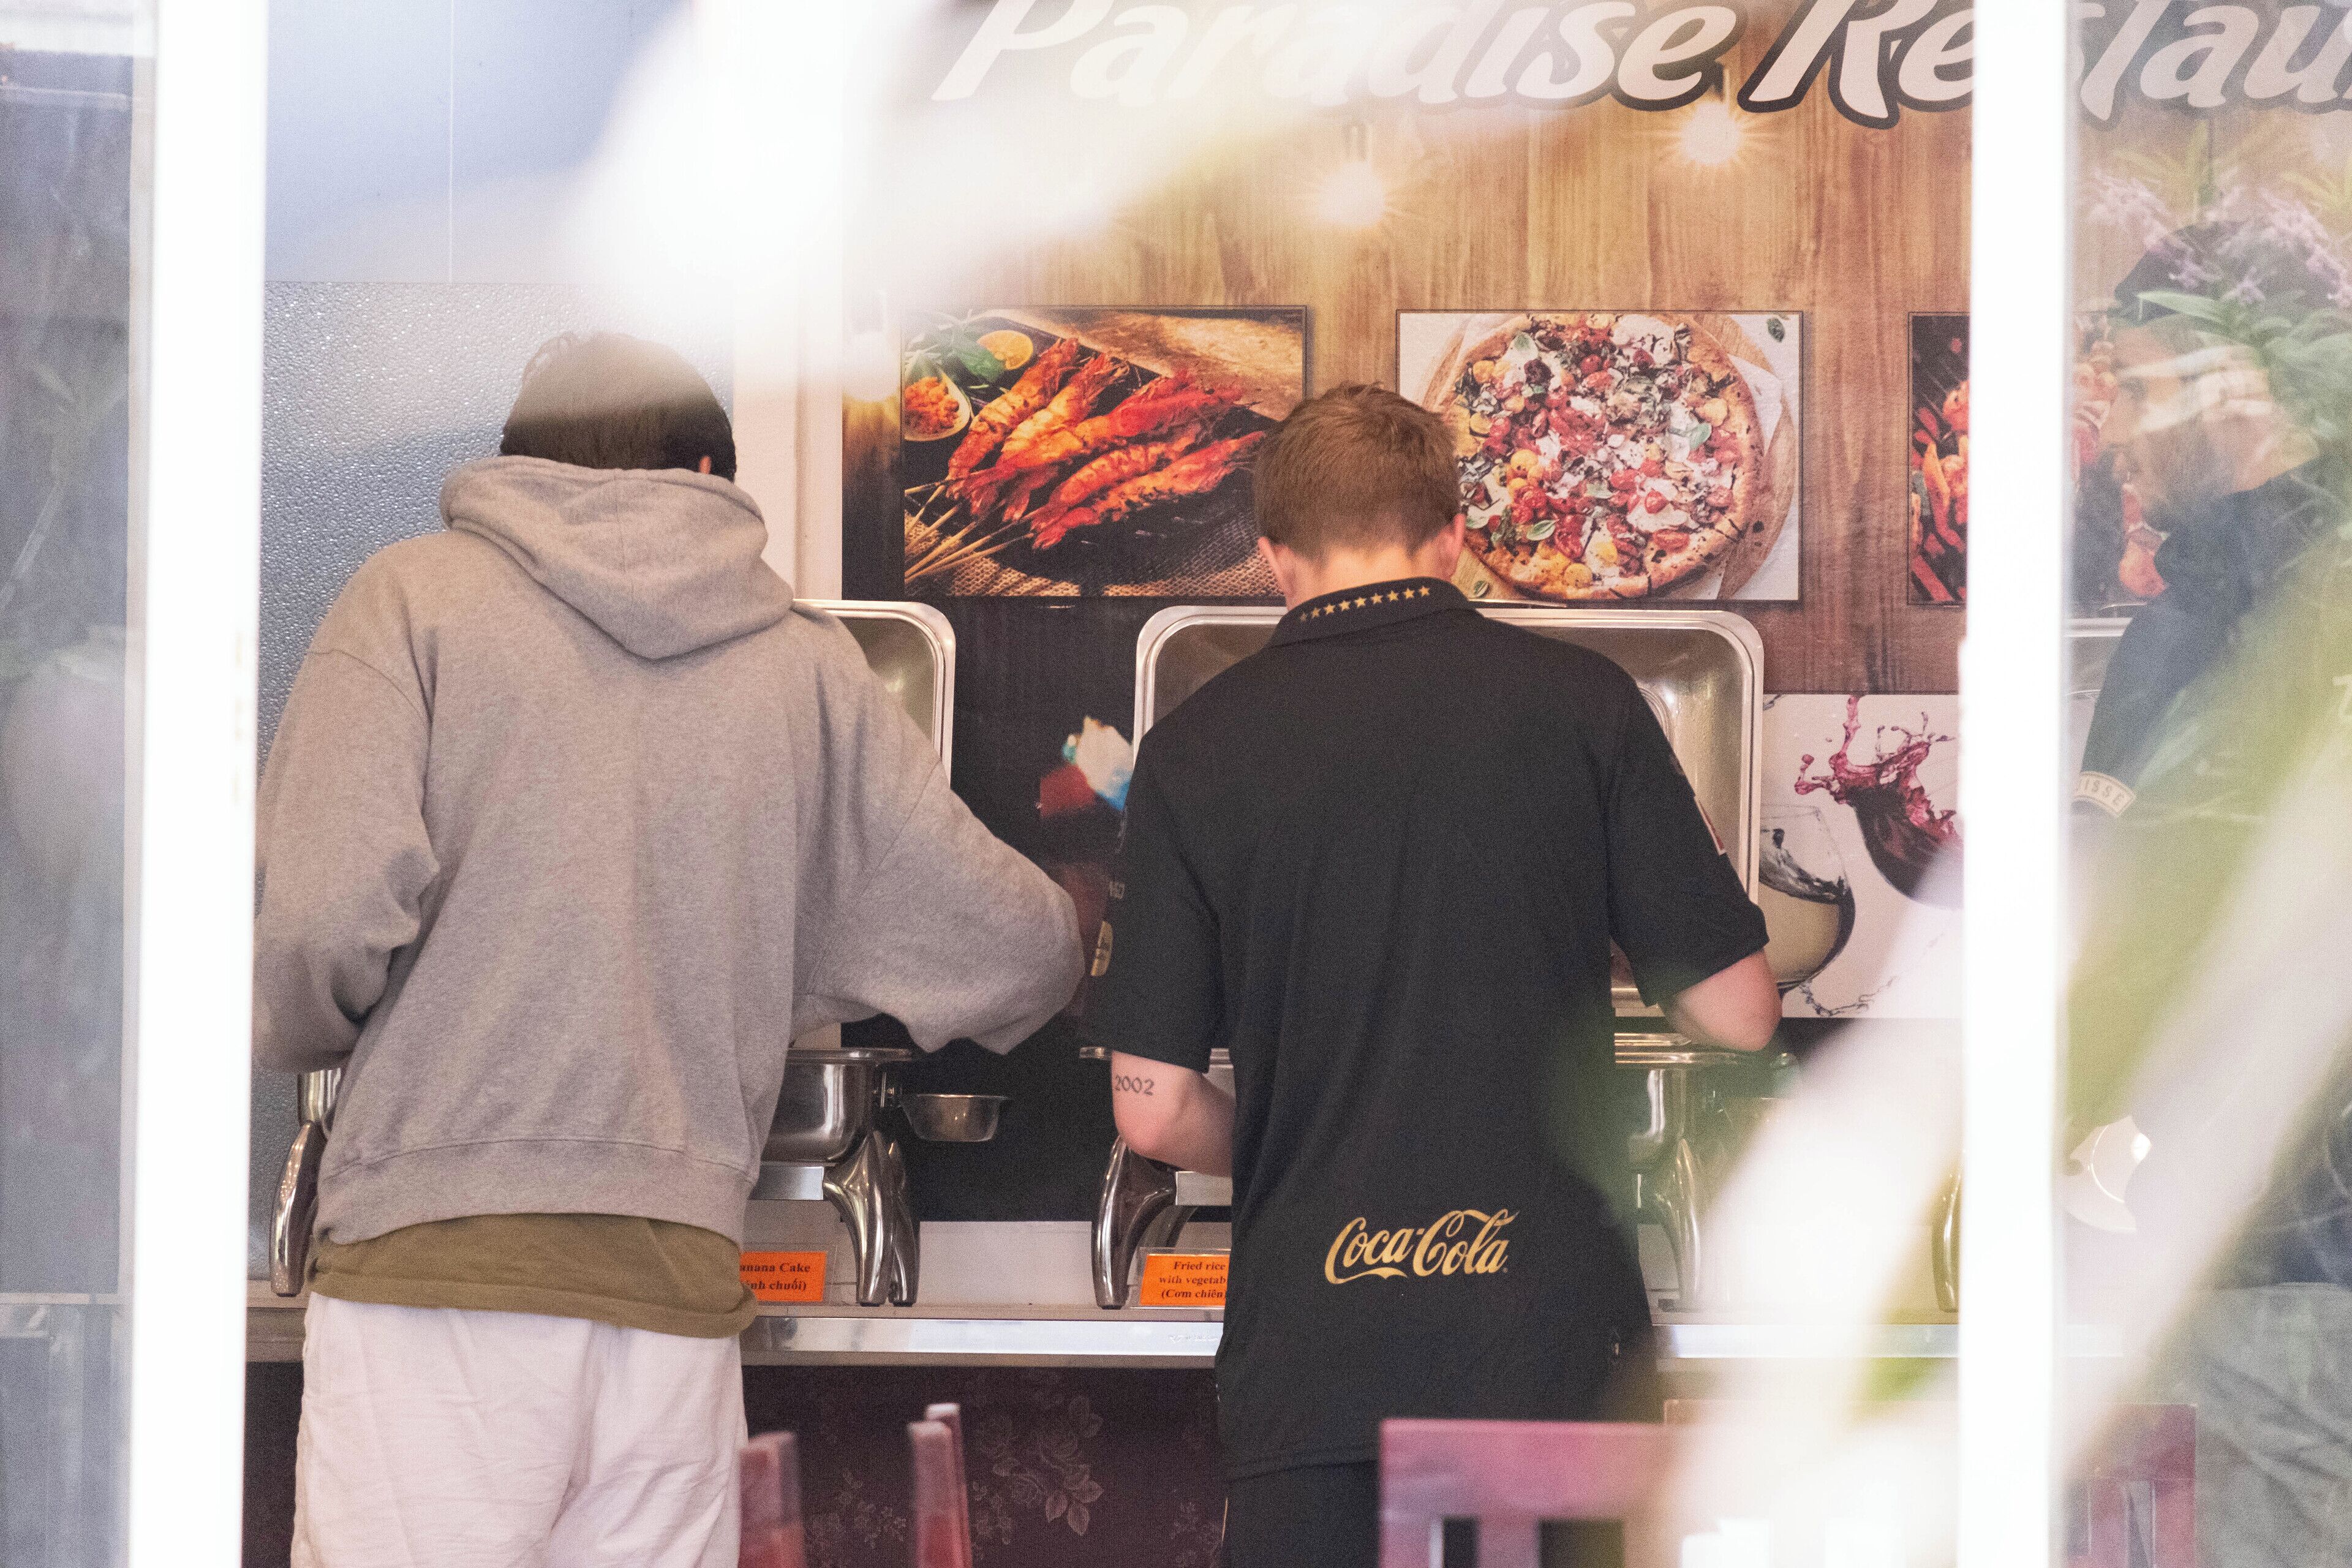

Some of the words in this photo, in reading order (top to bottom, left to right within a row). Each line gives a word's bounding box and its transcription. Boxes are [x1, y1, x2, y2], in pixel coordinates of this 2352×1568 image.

[929, 0, 1735, 113] Paradise
[1740, 0, 2352, 127] Retau
[1115, 1074, 1155, 1096] 2002
[1324, 1208, 1520, 1284] Coca-Cola
[779, 1262, 810, 1272] Cake
[1174, 1261, 1202, 1270] Fried
[1205, 1262, 1226, 1270] rice
[769, 1277, 807, 1292] chuối)
[1159, 1275, 1182, 1284] with
[1186, 1276, 1226, 1286] vegetab
[1194, 1289, 1227, 1299] chiên
